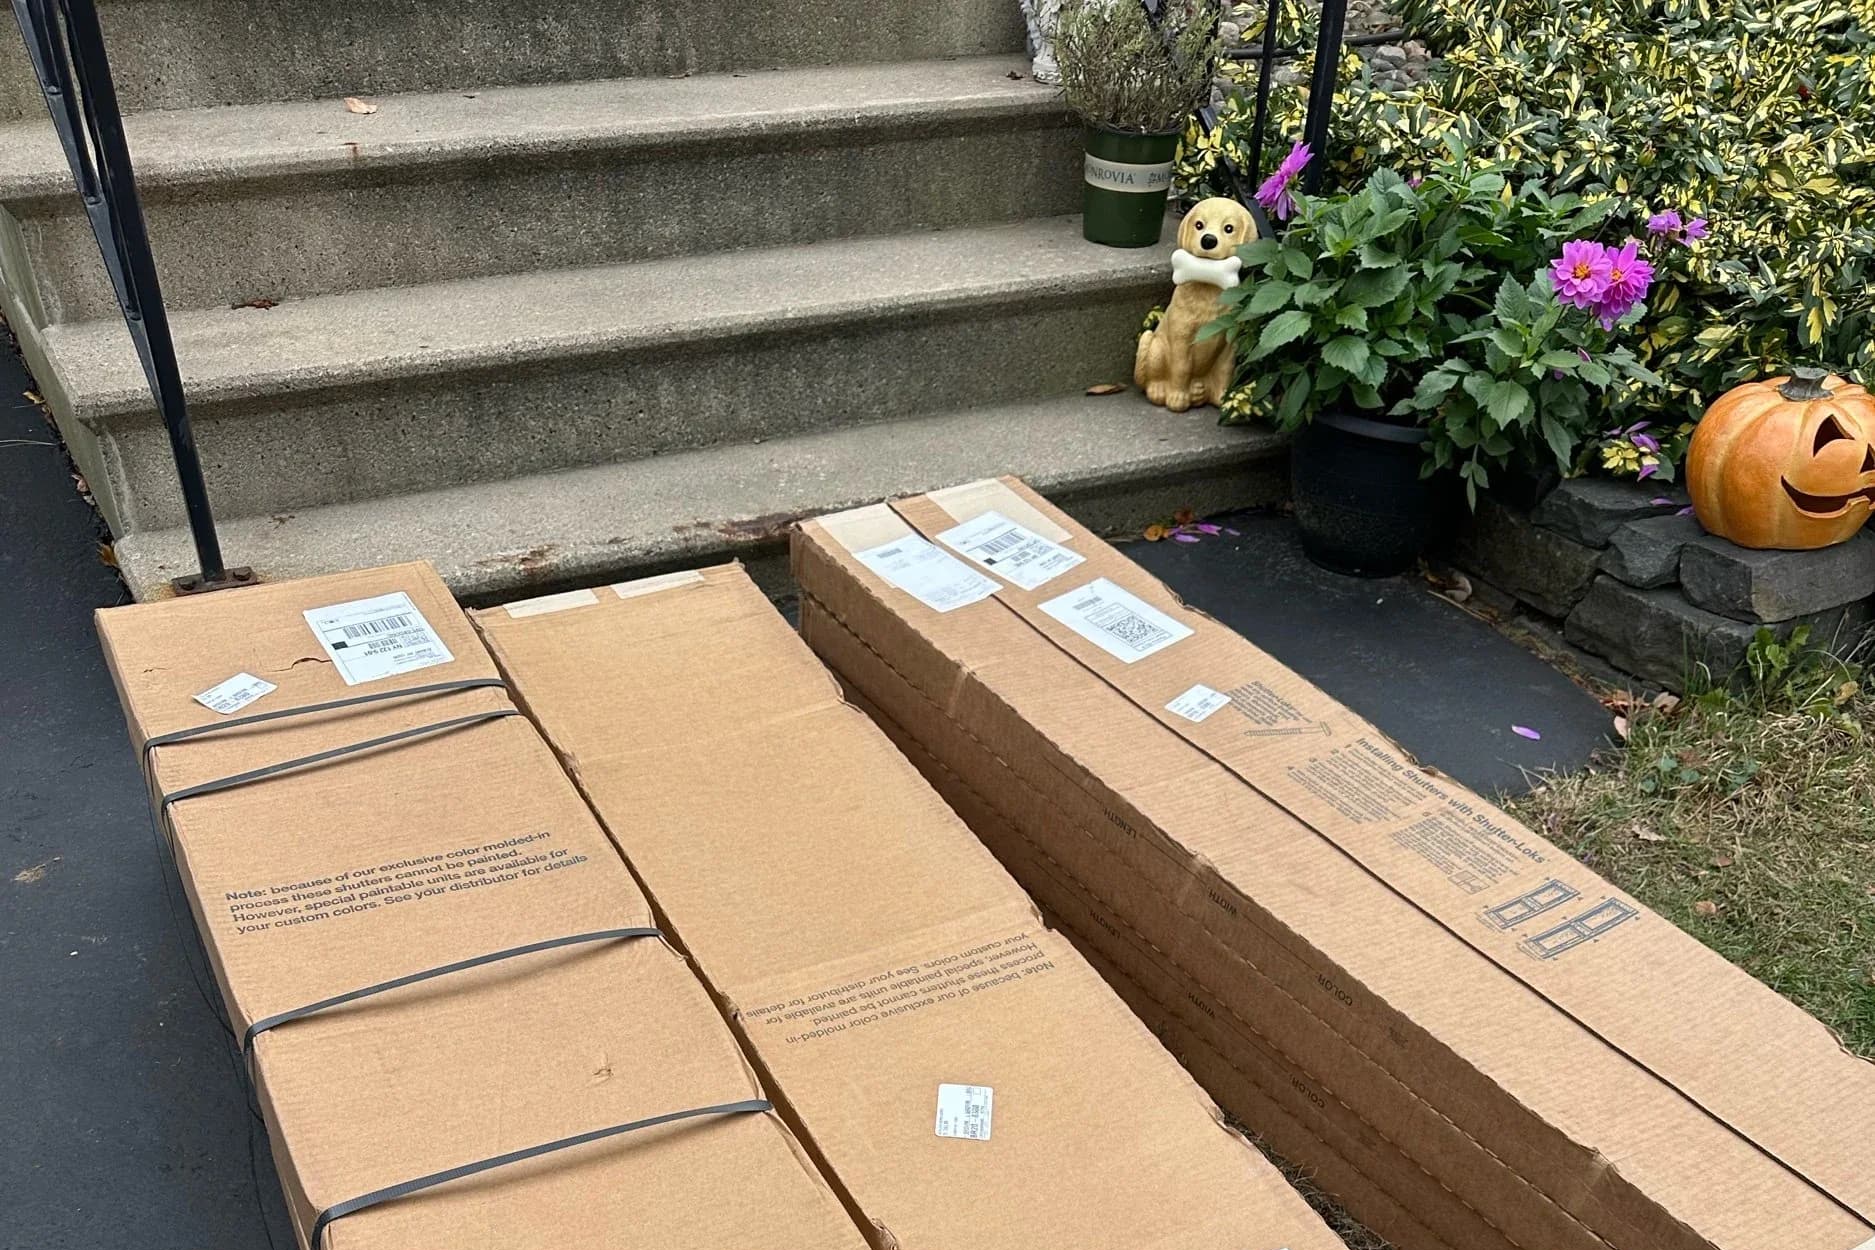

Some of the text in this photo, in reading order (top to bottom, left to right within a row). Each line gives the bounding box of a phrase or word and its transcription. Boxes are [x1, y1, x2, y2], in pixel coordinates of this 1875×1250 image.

[1355, 738, 1404, 772] Installing
[1402, 769, 1449, 800] Shutters
[1448, 799, 1474, 817] with
[225, 831, 551, 901] Note: because of our exclusive color molded-in
[230, 849, 522, 913] process these shutters cannot be painted.
[232, 848, 569, 922] However, special paintable units are available for
[236, 855, 588, 935] your custom colors. See your distributor for details
[1004, 932, 1029, 945] your
[960, 941, 1002, 958] custom
[999, 949, 1046, 970] process
[869, 971, 895, 985] your
[896, 966, 920, 976] See
[967, 967, 1000, 981] these
[765, 942, 1038, 1025] However, special paintable units are available for
[807, 980, 866, 1002] distributor
[919, 976, 967, 994] shutters
[785, 960, 1056, 1044] Note: because of our exclusive color molded-in
[788, 998, 805, 1008] for
[860, 1002, 877, 1012] be
[877, 990, 918, 1007] cannot
[746, 1003, 786, 1018] details
